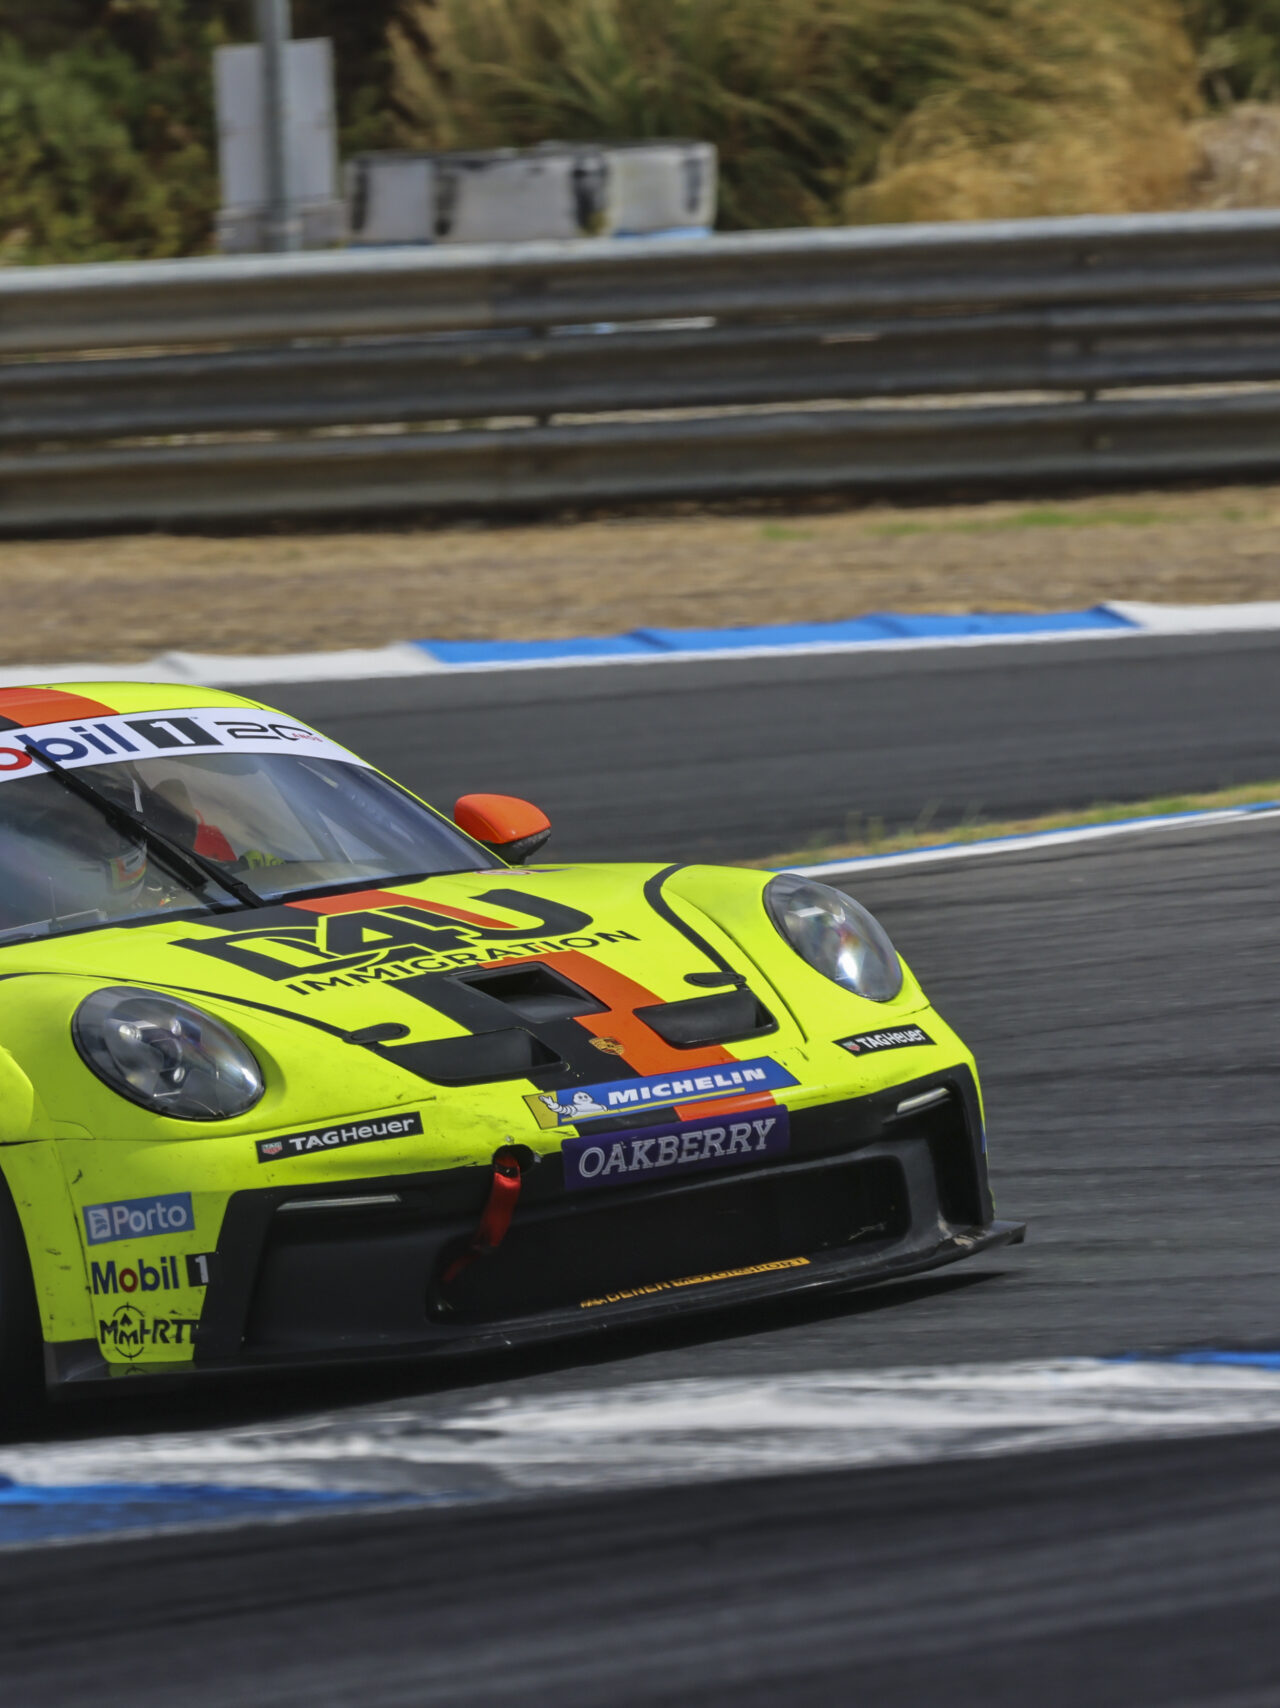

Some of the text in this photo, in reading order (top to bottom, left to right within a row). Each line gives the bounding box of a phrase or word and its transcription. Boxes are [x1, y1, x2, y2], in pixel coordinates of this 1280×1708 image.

[149, 720, 197, 745] 1
[166, 887, 595, 982] D4U
[284, 929, 642, 996] IMMIGRATION
[607, 1066, 767, 1106] MICHELIN
[577, 1116, 777, 1179] OAKBERRY
[111, 1202, 188, 1236] Porto
[91, 1254, 210, 1296] Mobil 1
